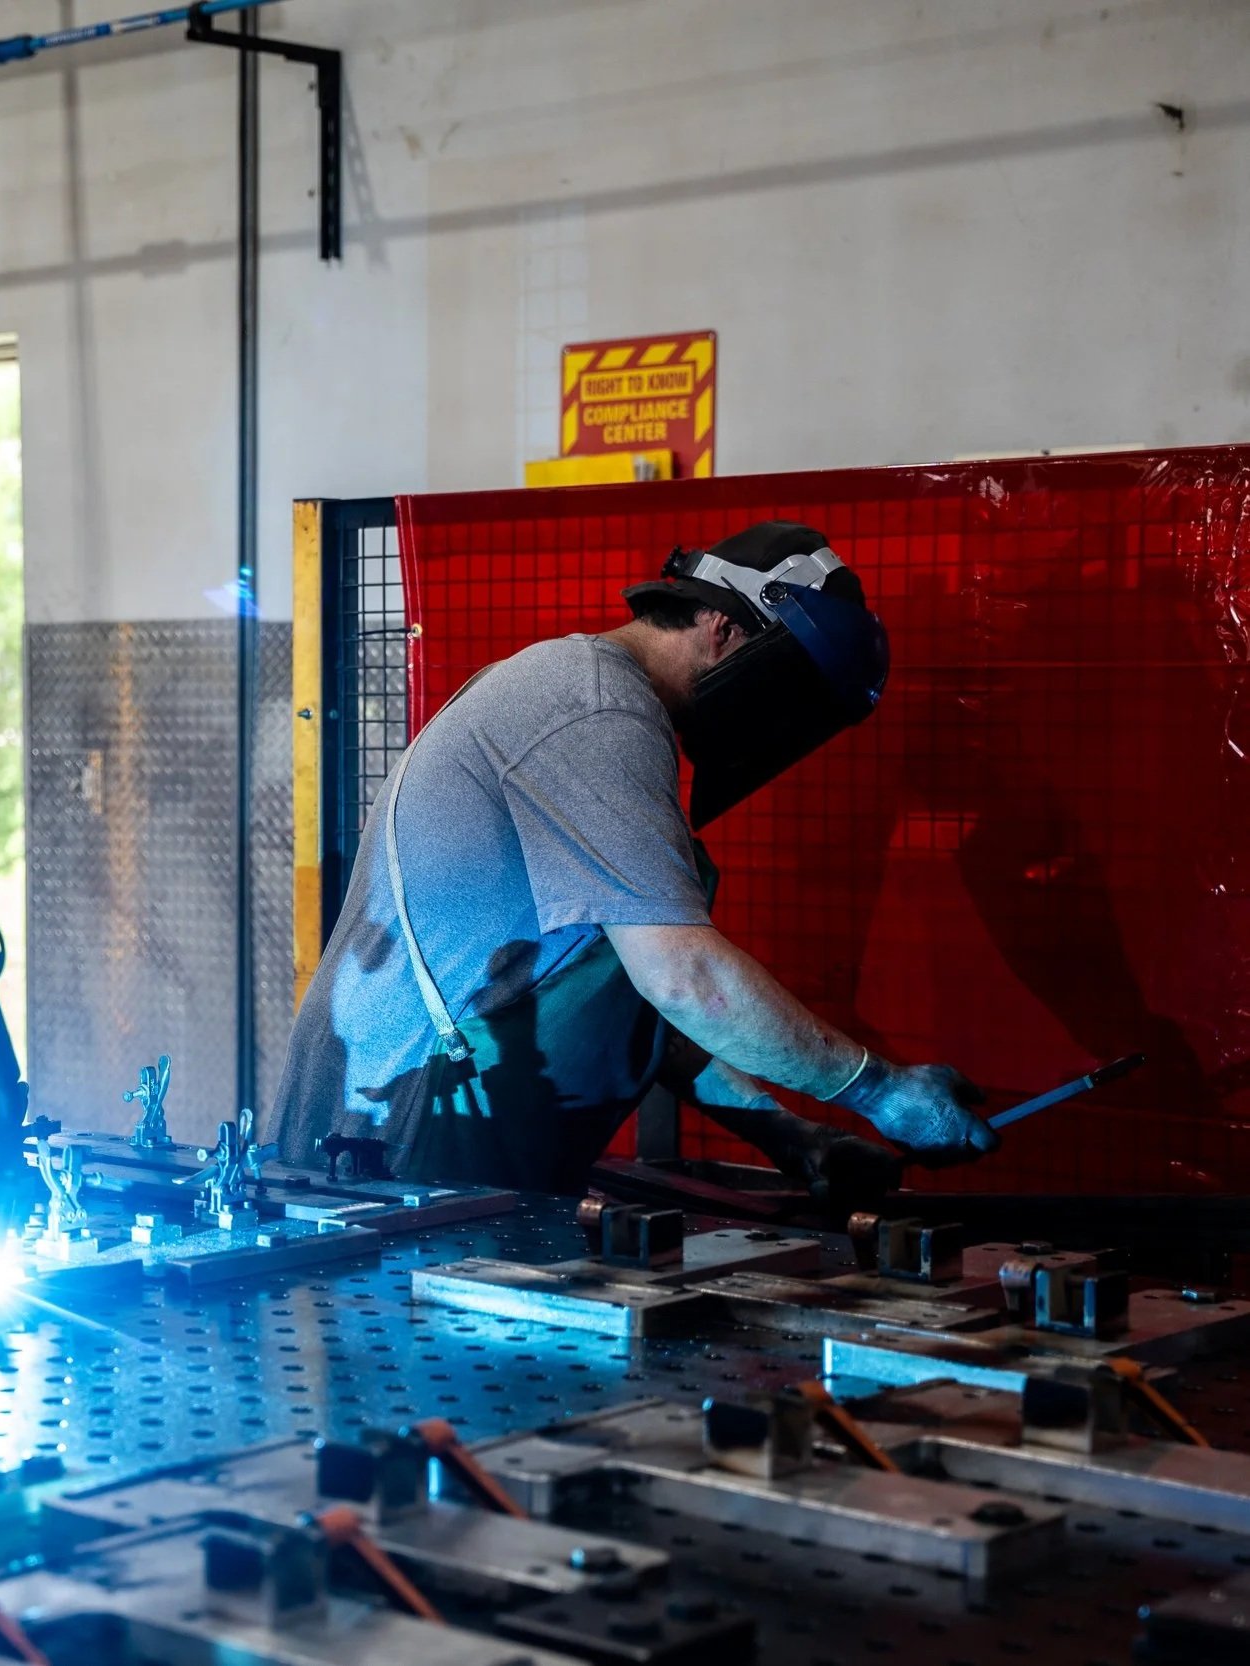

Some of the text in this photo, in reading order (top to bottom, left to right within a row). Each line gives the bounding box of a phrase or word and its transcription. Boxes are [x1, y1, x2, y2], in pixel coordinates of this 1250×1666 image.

[586, 371, 688, 396] RIGHT TO KNOW
[583, 399, 689, 426] COMPLIANCE
[603, 421, 668, 444] CENTER
